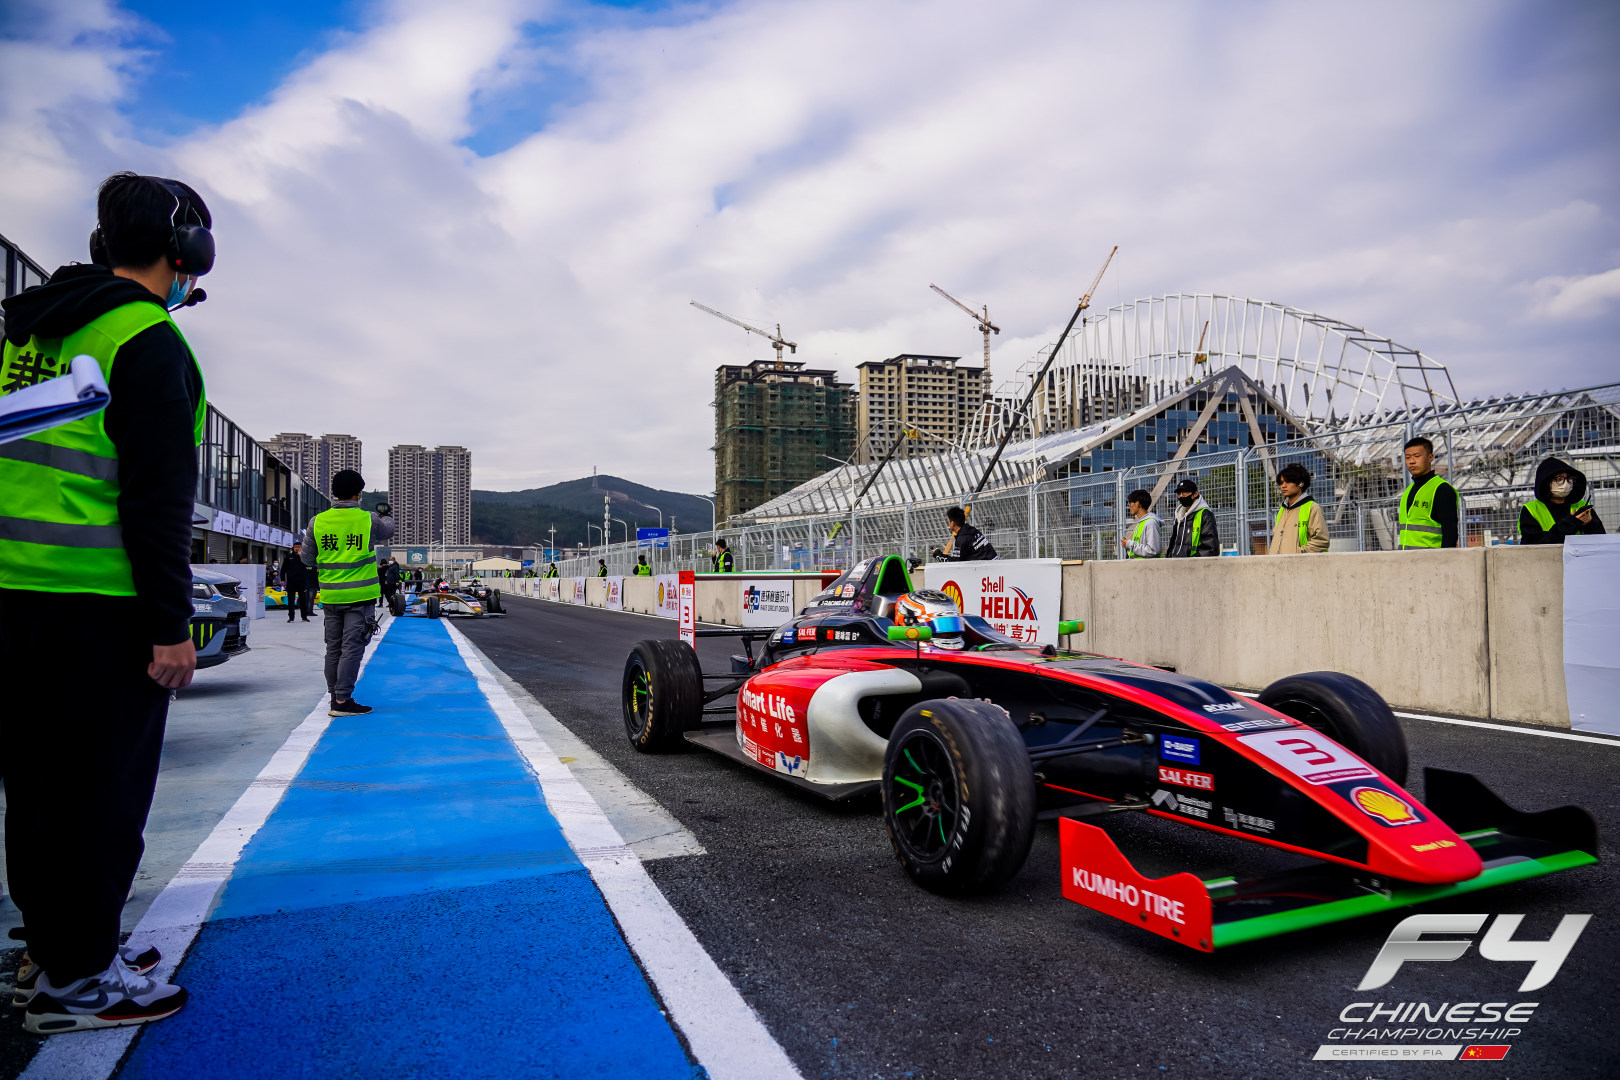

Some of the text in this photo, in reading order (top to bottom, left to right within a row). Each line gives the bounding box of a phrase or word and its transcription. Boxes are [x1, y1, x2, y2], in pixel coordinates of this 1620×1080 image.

[321, 534, 363, 551] 裁判
[981, 576, 1004, 593] Shell
[684, 606, 690, 624] 3
[981, 593, 1037, 621] HELIX
[743, 682, 796, 724] Smart Life
[1221, 718, 1292, 732] GEELY
[1276, 738, 1336, 766] 3
[1159, 769, 1212, 789] SAL-FER
[1073, 866, 1186, 925] KUMHO TIRE
